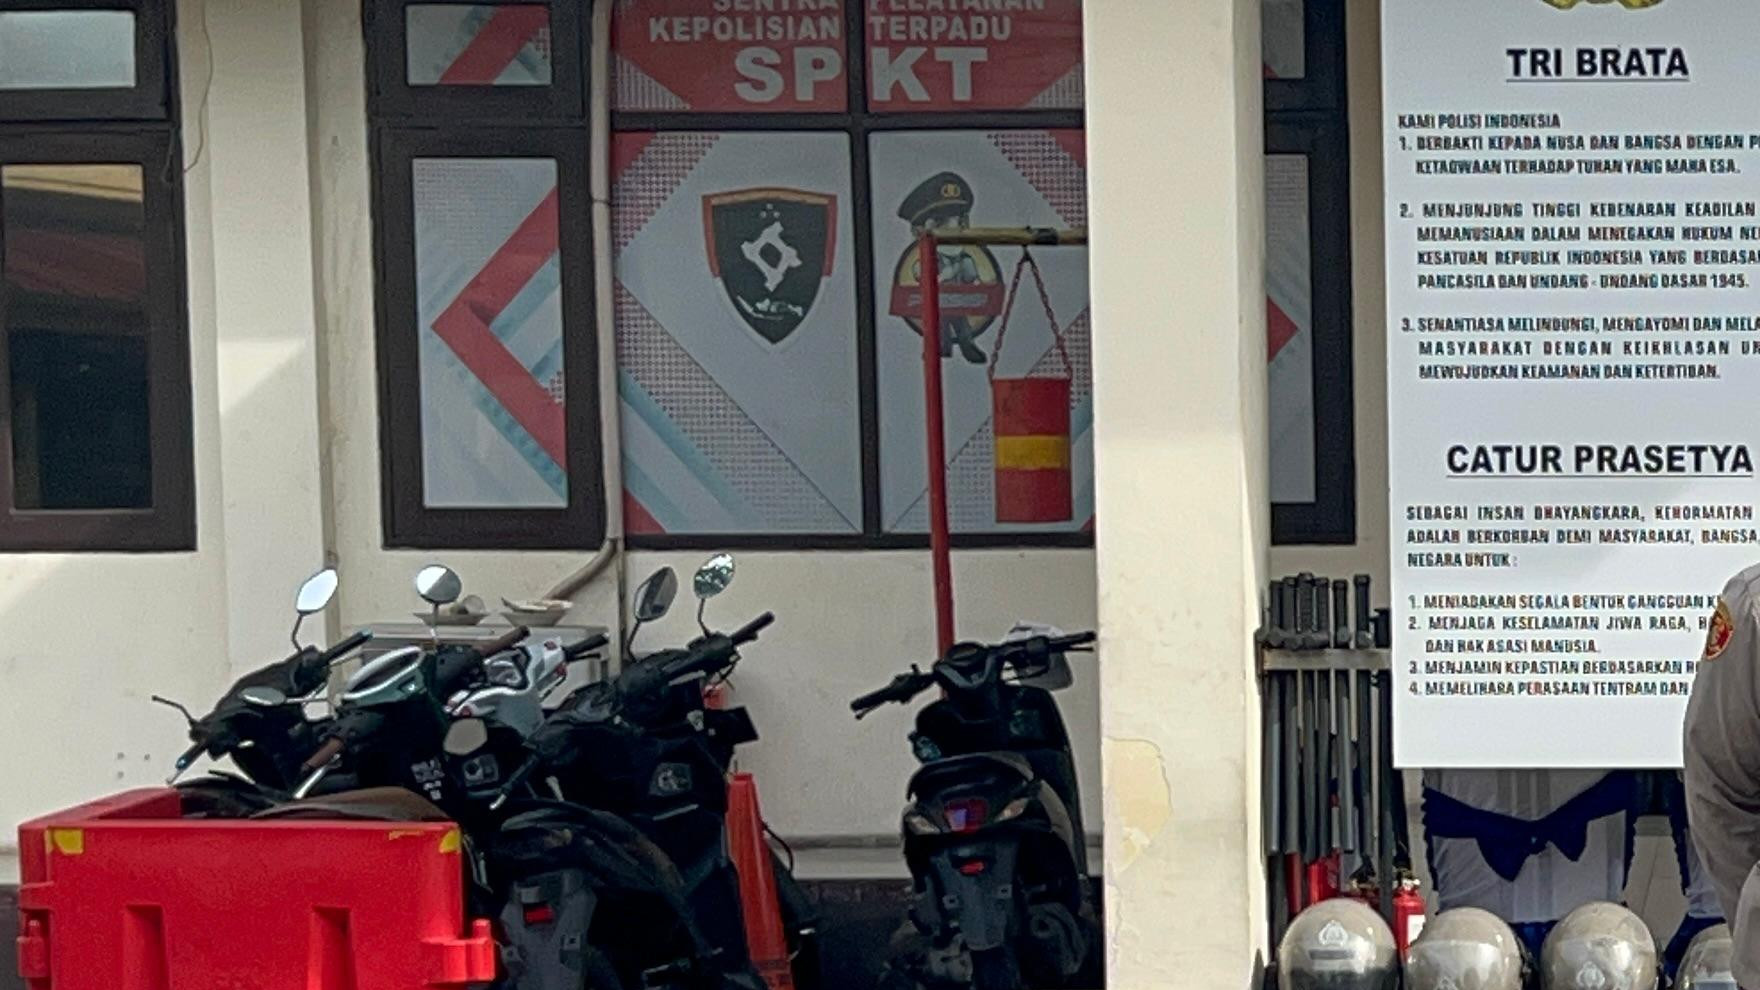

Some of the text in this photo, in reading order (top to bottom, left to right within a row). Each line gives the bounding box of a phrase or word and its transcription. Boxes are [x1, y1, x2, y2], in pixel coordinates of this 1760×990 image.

[650, 16, 1011, 42] KEPOLISIAN TERPADU
[1506, 48, 1689, 77] TRI BRATA
[1398, 114, 1560, 129] KAMI POLISI INDONESIA
[1417, 136, 1483, 150] BERBAKTI
[1488, 135, 1541, 150] KEPADA
[1546, 135, 1585, 150] NUSA
[1590, 135, 1619, 150] DAN
[1624, 135, 1682, 150] BANGSA
[1687, 134, 1744, 150] DENGAN
[1504, 159, 1574, 174] TERHADAP
[1576, 159, 1622, 174] TUHAN
[1624, 159, 1662, 174] YANG
[1665, 159, 1707, 174] MAHA
[1422, 203, 1523, 218] MENJUNJUNG
[1532, 203, 1580, 218] TINGGI
[1590, 202, 1676, 217] KEBENARAN
[1685, 202, 1755, 217] KEADILAN
[1531, 226, 1580, 241] DALAM
[1588, 226, 1675, 241] MENEGAKAN
[1681, 226, 1733, 241] HUKUM
[1417, 251, 1487, 265] KESATUAN
[1495, 250, 1560, 265] REPUBLIK
[1567, 250, 1643, 265] INDONESIA
[1649, 250, 1687, 265] YANG
[1417, 274, 1495, 289] PANCASILA
[1498, 274, 1527, 289] DAN
[1530, 274, 1589, 288] UNDANG
[1600, 274, 1658, 288] UNDANG
[1661, 273, 1707, 288] DASAR
[1710, 273, 1749, 288] 1945.
[1418, 317, 1505, 332] SENANTIASA
[1603, 317, 1689, 331] MENGAYOMI
[1693, 317, 1722, 331] DAN
[1419, 341, 1532, 356] MASYARAKAT
[1543, 341, 1612, 356] DENGAN
[1623, 341, 1729, 355] KEIKHLASAN
[1419, 365, 1518, 379] MEWUJUDKAN
[1522, 364, 1600, 379] KEAMANAN
[1603, 364, 1632, 379] DAN
[1446, 444, 1753, 473] CATUR PRASETYA
[1406, 506, 1468, 520] SEBAGAI
[1478, 506, 1524, 520] INSAN
[1654, 505, 1752, 520] KEHORMATAN
[1406, 529, 1460, 543] ADALAH
[1467, 529, 1549, 543] BERKORBAN
[1556, 529, 1591, 543] DEMI
[1408, 552, 1462, 567] NEGARA
[1424, 595, 1516, 609] MENIADAKAN
[1519, 595, 1569, 609] SEGALA
[1572, 595, 1625, 609] BENTUK
[1628, 595, 1703, 609] GANGGUAN
[1428, 616, 1496, 630] MENJAGA
[1502, 616, 1599, 630] KESELAMATAN
[1606, 616, 1642, 630] JIWA
[1426, 639, 1454, 653] DAN
[1457, 639, 1484, 653] HAK
[1486, 639, 1528, 653] ASASI
[1425, 661, 1502, 674] MENJAMIN
[1504, 661, 1579, 674] KEPASTIAN
[1583, 661, 1682, 674] BERDASARKAN
[1425, 681, 1515, 695] MEMELIHARA
[1517, 681, 1590, 695] PERASAAN
[1592, 681, 1657, 695] TENTRAM
[1660, 681, 1689, 695] DAN
